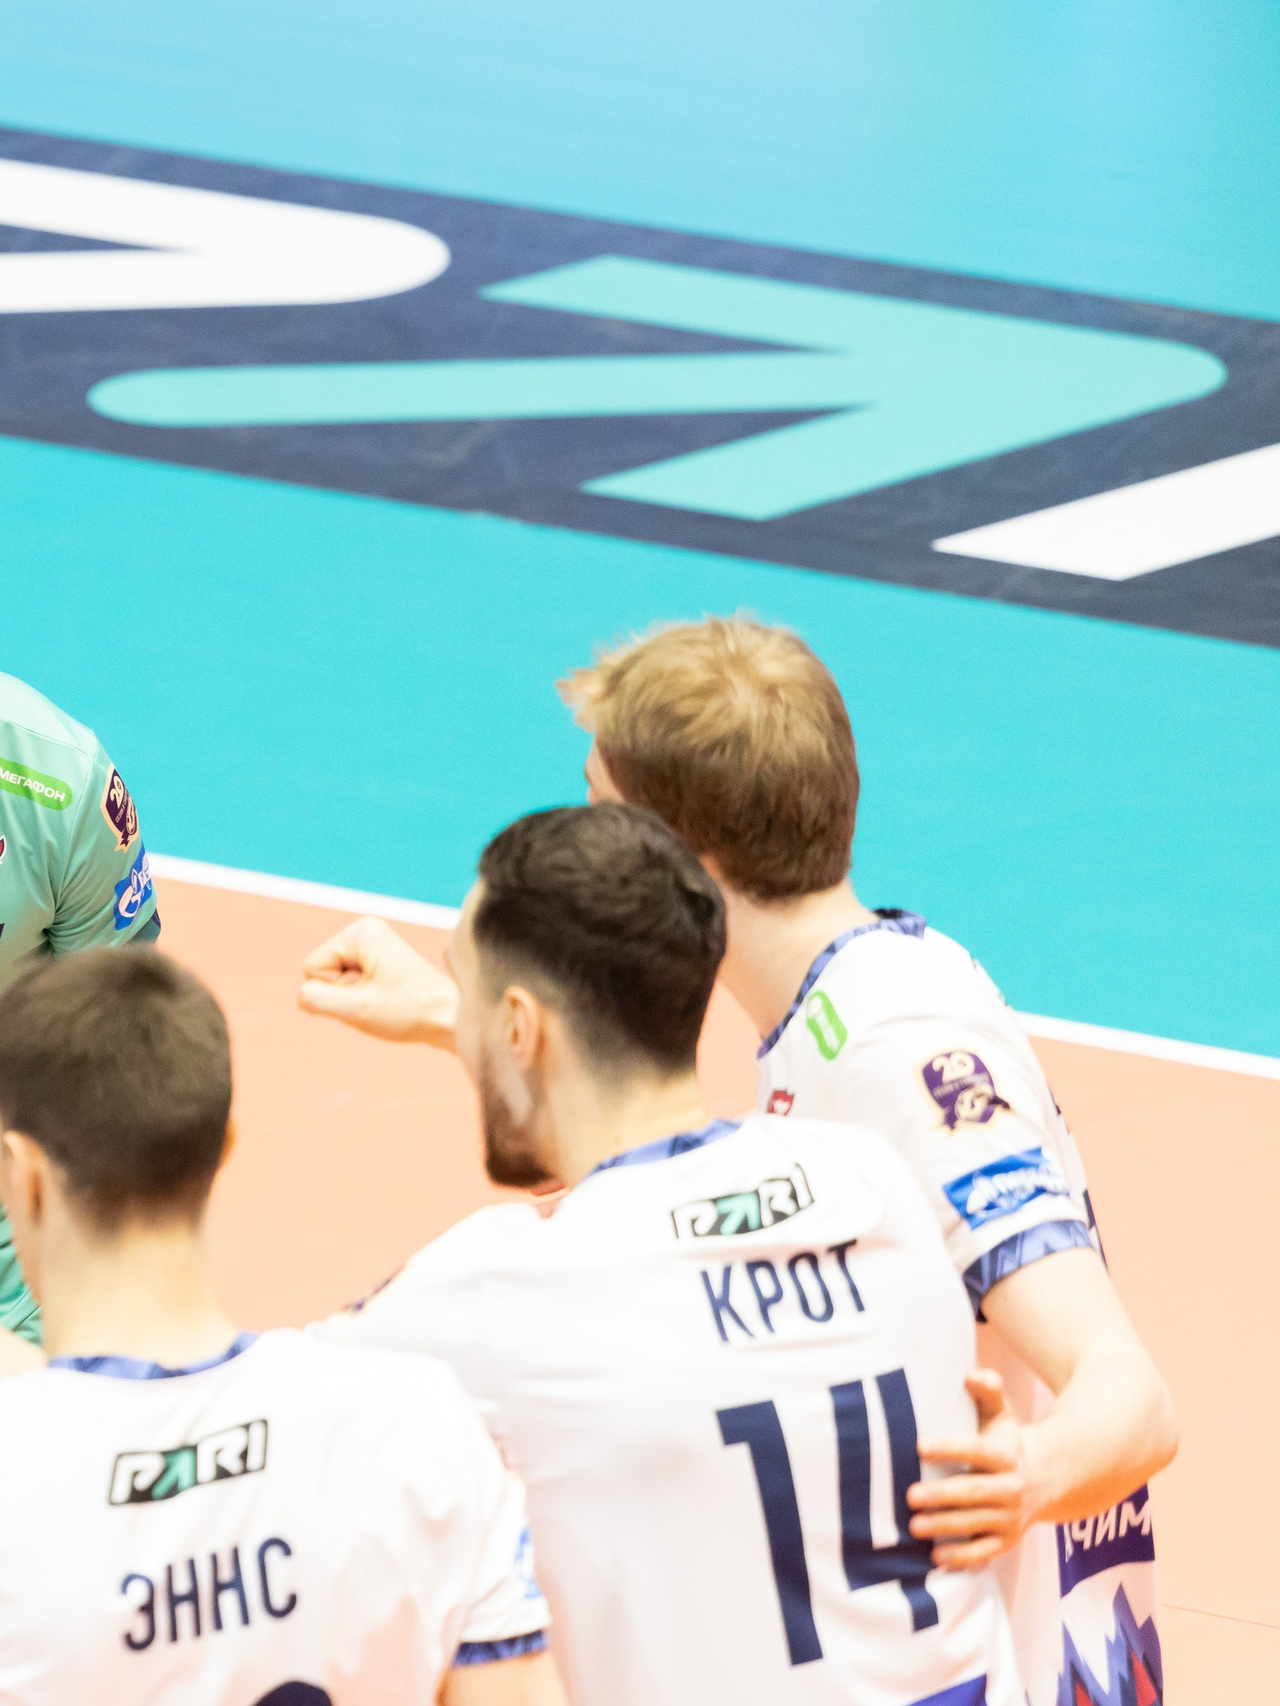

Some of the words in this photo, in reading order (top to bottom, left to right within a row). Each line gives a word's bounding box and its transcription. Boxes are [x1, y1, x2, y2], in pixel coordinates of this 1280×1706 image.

[109, 775, 125, 809] 20
[931, 1051, 976, 1084] 20
[701, 1239, 865, 1342] КРОТ
[110, 1419, 268, 1504] PARI
[716, 1368, 939, 1667] 14
[121, 1538, 297, 1652] ЭННС
